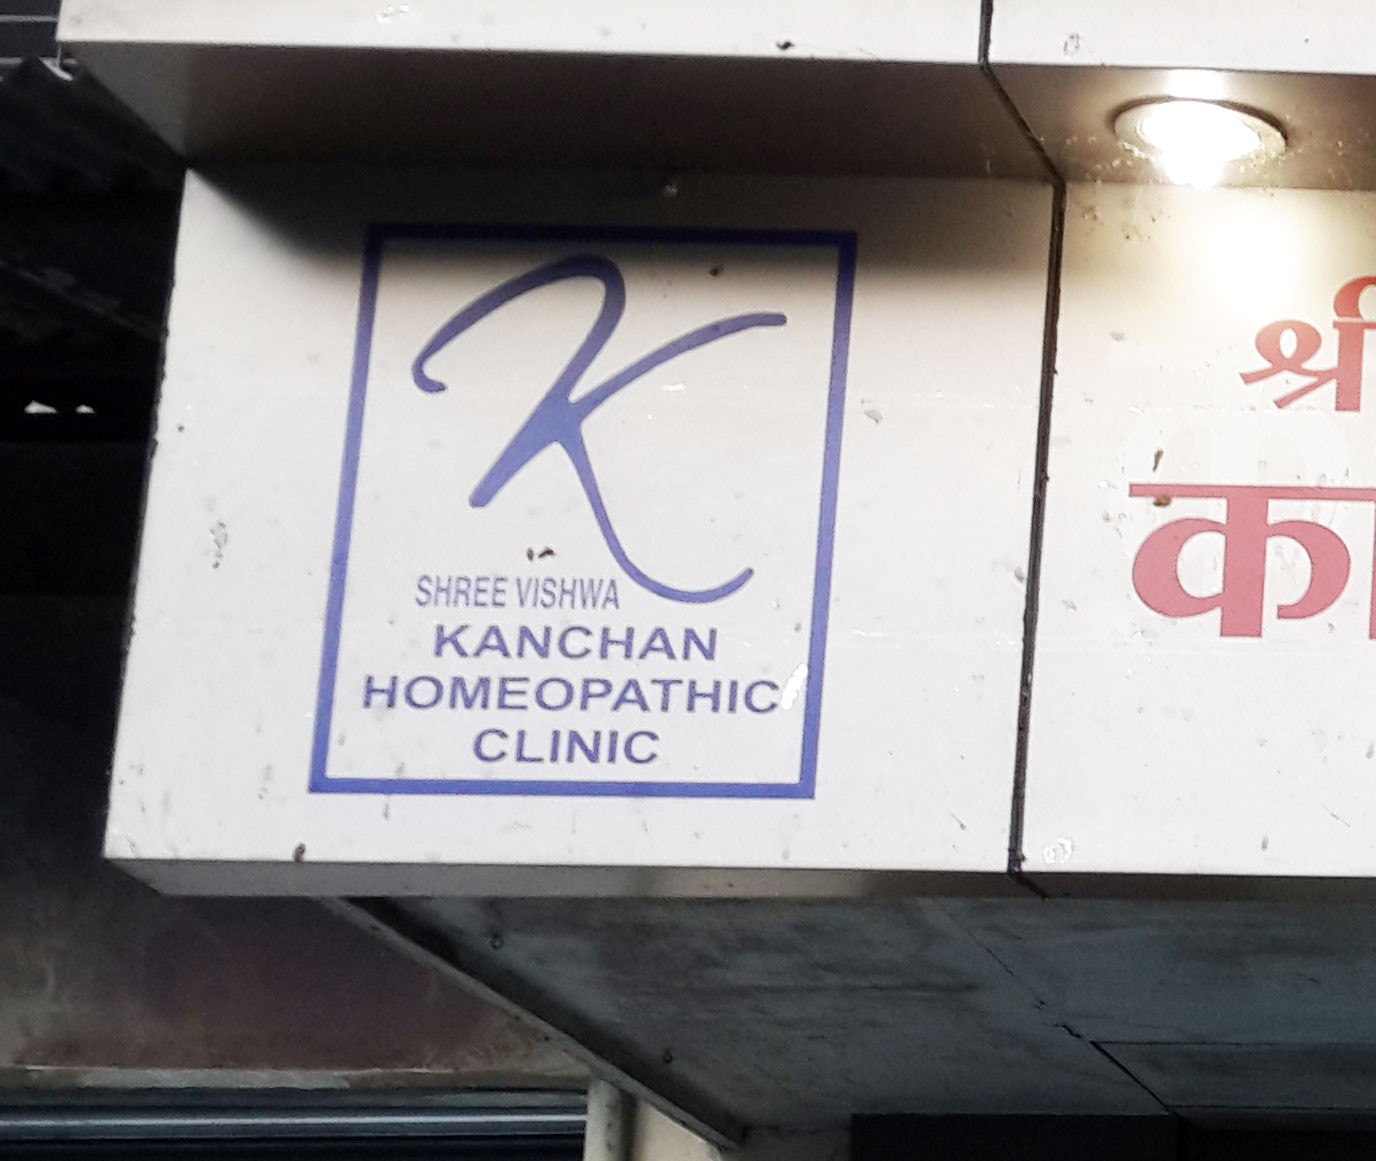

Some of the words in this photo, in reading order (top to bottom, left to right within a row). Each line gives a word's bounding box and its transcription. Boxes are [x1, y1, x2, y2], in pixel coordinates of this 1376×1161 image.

[412, 254, 787, 604] K
[415, 575, 508, 609] SHREE
[515, 576, 621, 610] VISHWA
[433, 624, 718, 661] KANCHAN
[363, 675, 779, 713] HOMEOPATHIC
[473, 728, 660, 765] CLINIC
